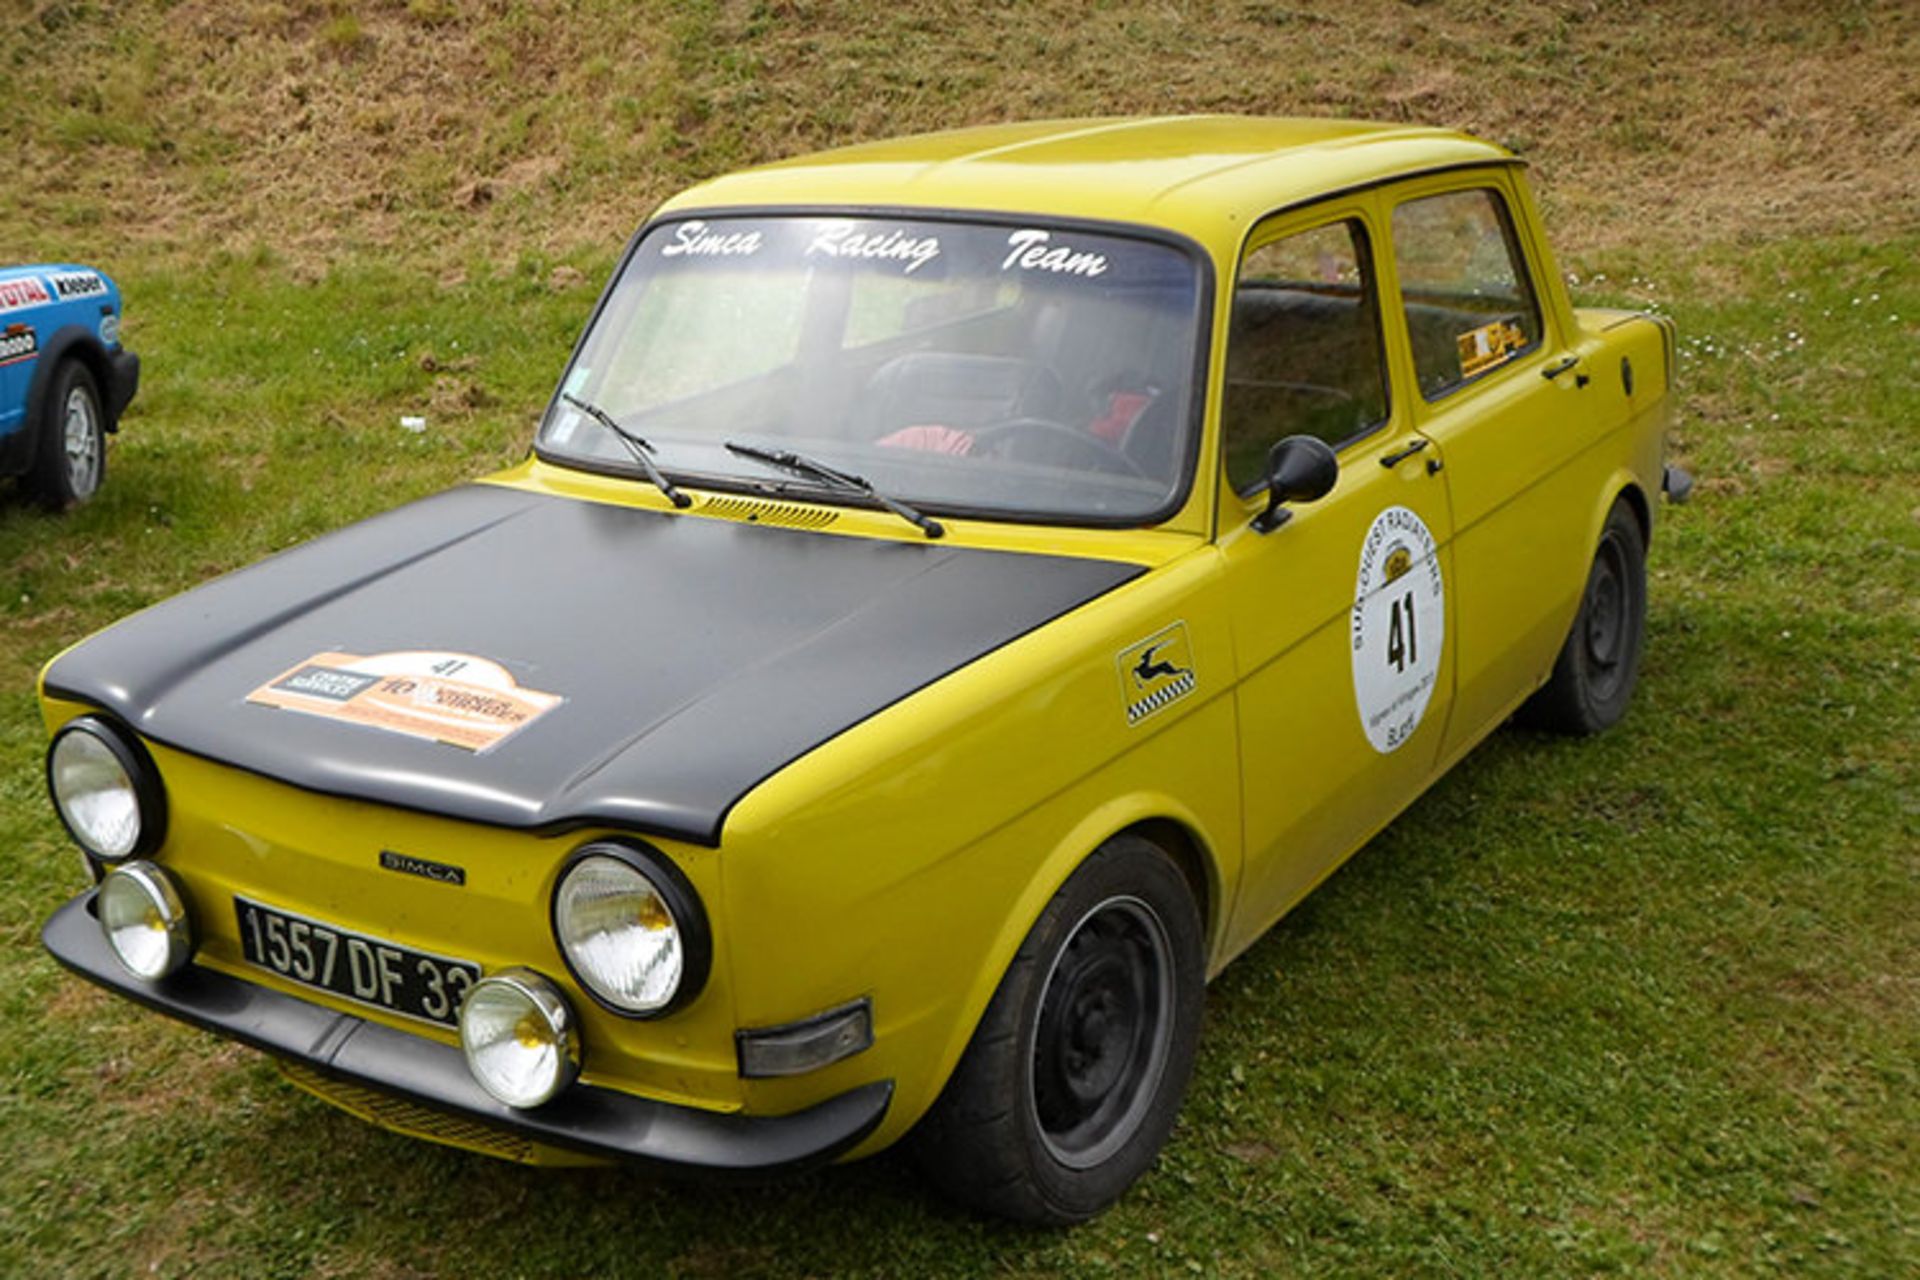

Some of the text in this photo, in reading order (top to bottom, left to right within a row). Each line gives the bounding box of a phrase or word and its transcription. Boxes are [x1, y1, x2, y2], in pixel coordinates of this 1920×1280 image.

[662, 221, 1108, 277] Simca Racing Team
[1387, 590, 1416, 673] 41
[431, 659, 469, 677] 41
[384, 852, 461, 884] SIMCA
[246, 908, 338, 987] 1557
[347, 938, 403, 1005] DF
